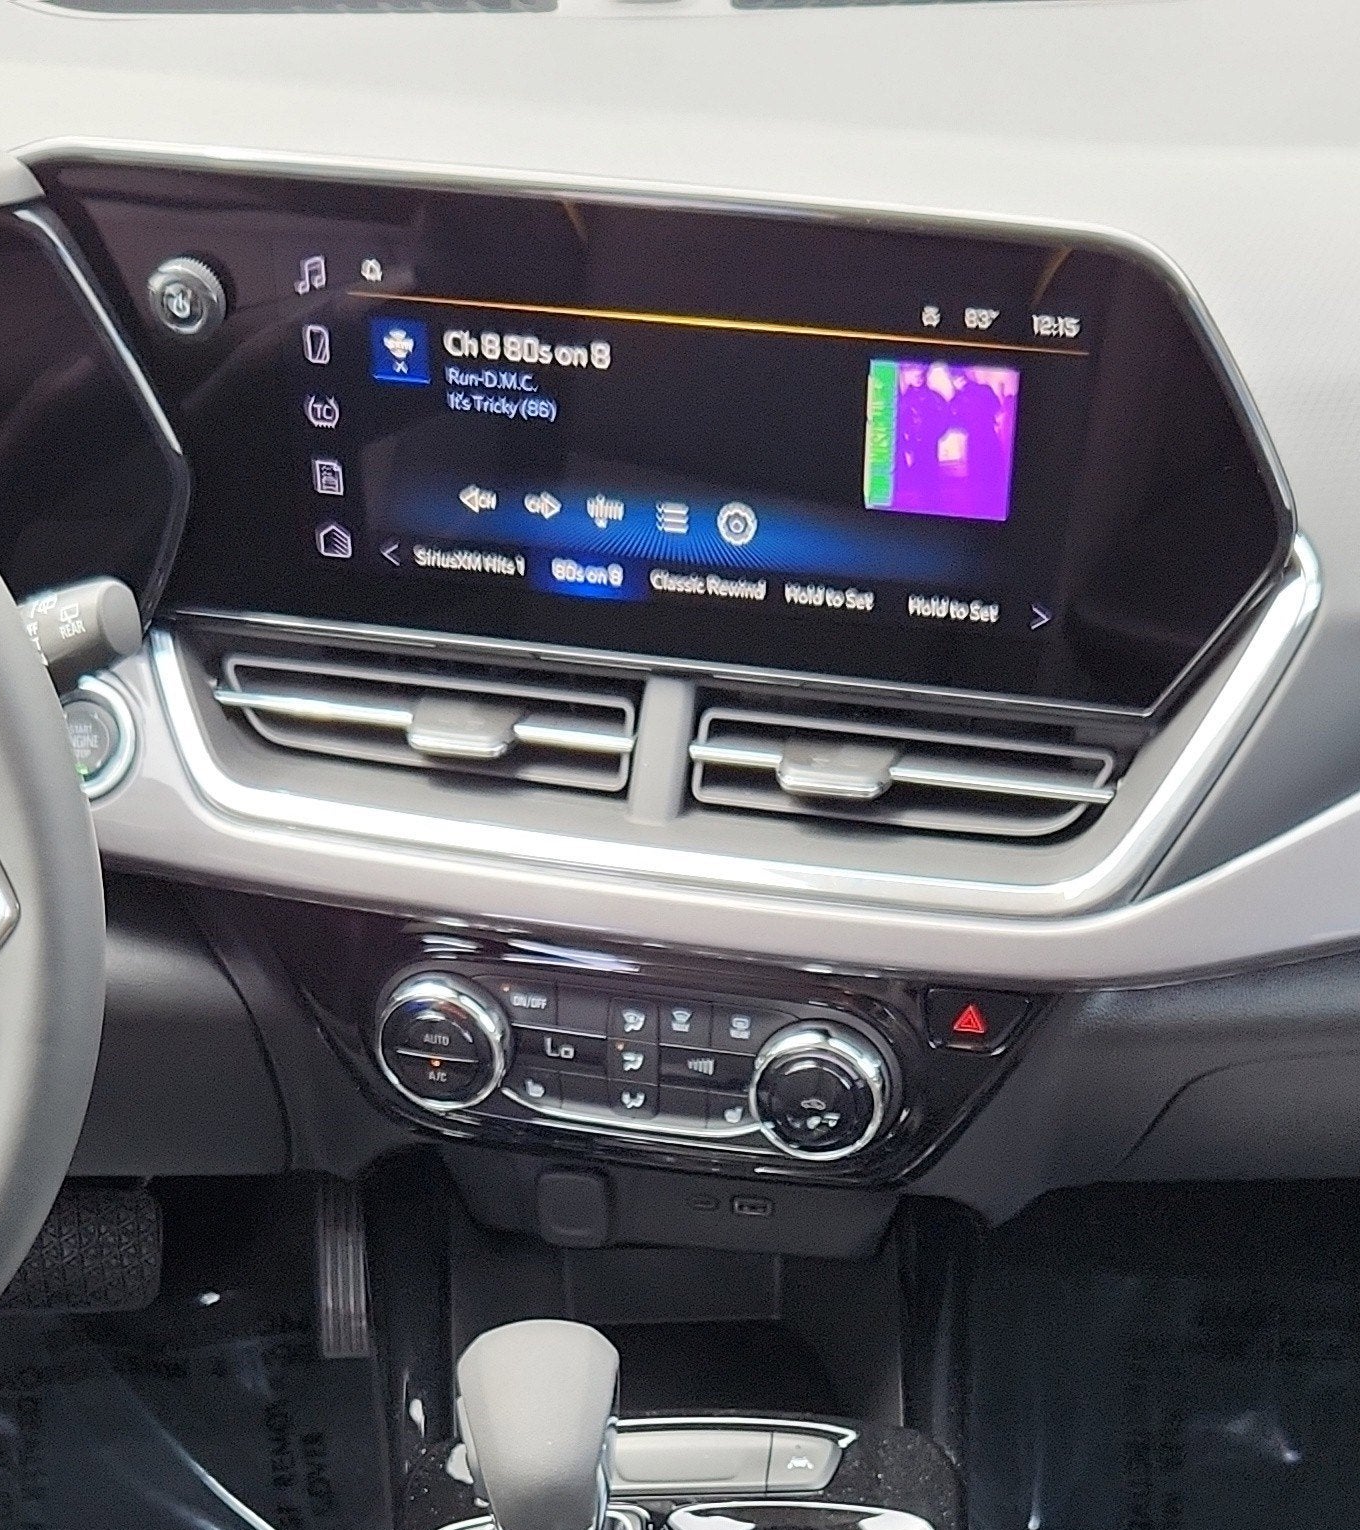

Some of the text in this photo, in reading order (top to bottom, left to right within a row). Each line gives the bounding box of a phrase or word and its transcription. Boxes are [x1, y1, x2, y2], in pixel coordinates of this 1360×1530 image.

[1032, 314, 1081, 338] 12:15
[443, 330, 479, 358] Ch
[480, 332, 501, 360] 8
[503, 334, 553, 364] 80s
[554, 345, 589, 368] on
[590, 340, 611, 370] 8
[447, 391, 558, 423] It's Tricky (86)
[413, 544, 482, 573] SiriusXM
[482, 551, 515, 576] Hits
[551, 557, 624, 587] 80s on 8
[650, 569, 768, 601] Classic Rewind
[784, 583, 876, 612] Hold to Set
[908, 594, 1000, 624] Hold to Set
[59, 619, 86, 640] REAR
[72, 734, 99, 749] NGINE
[423, 1033, 450, 1047] AUTO
[544, 1037, 575, 1060] Lo
[428, 1070, 448, 1084] A/C
